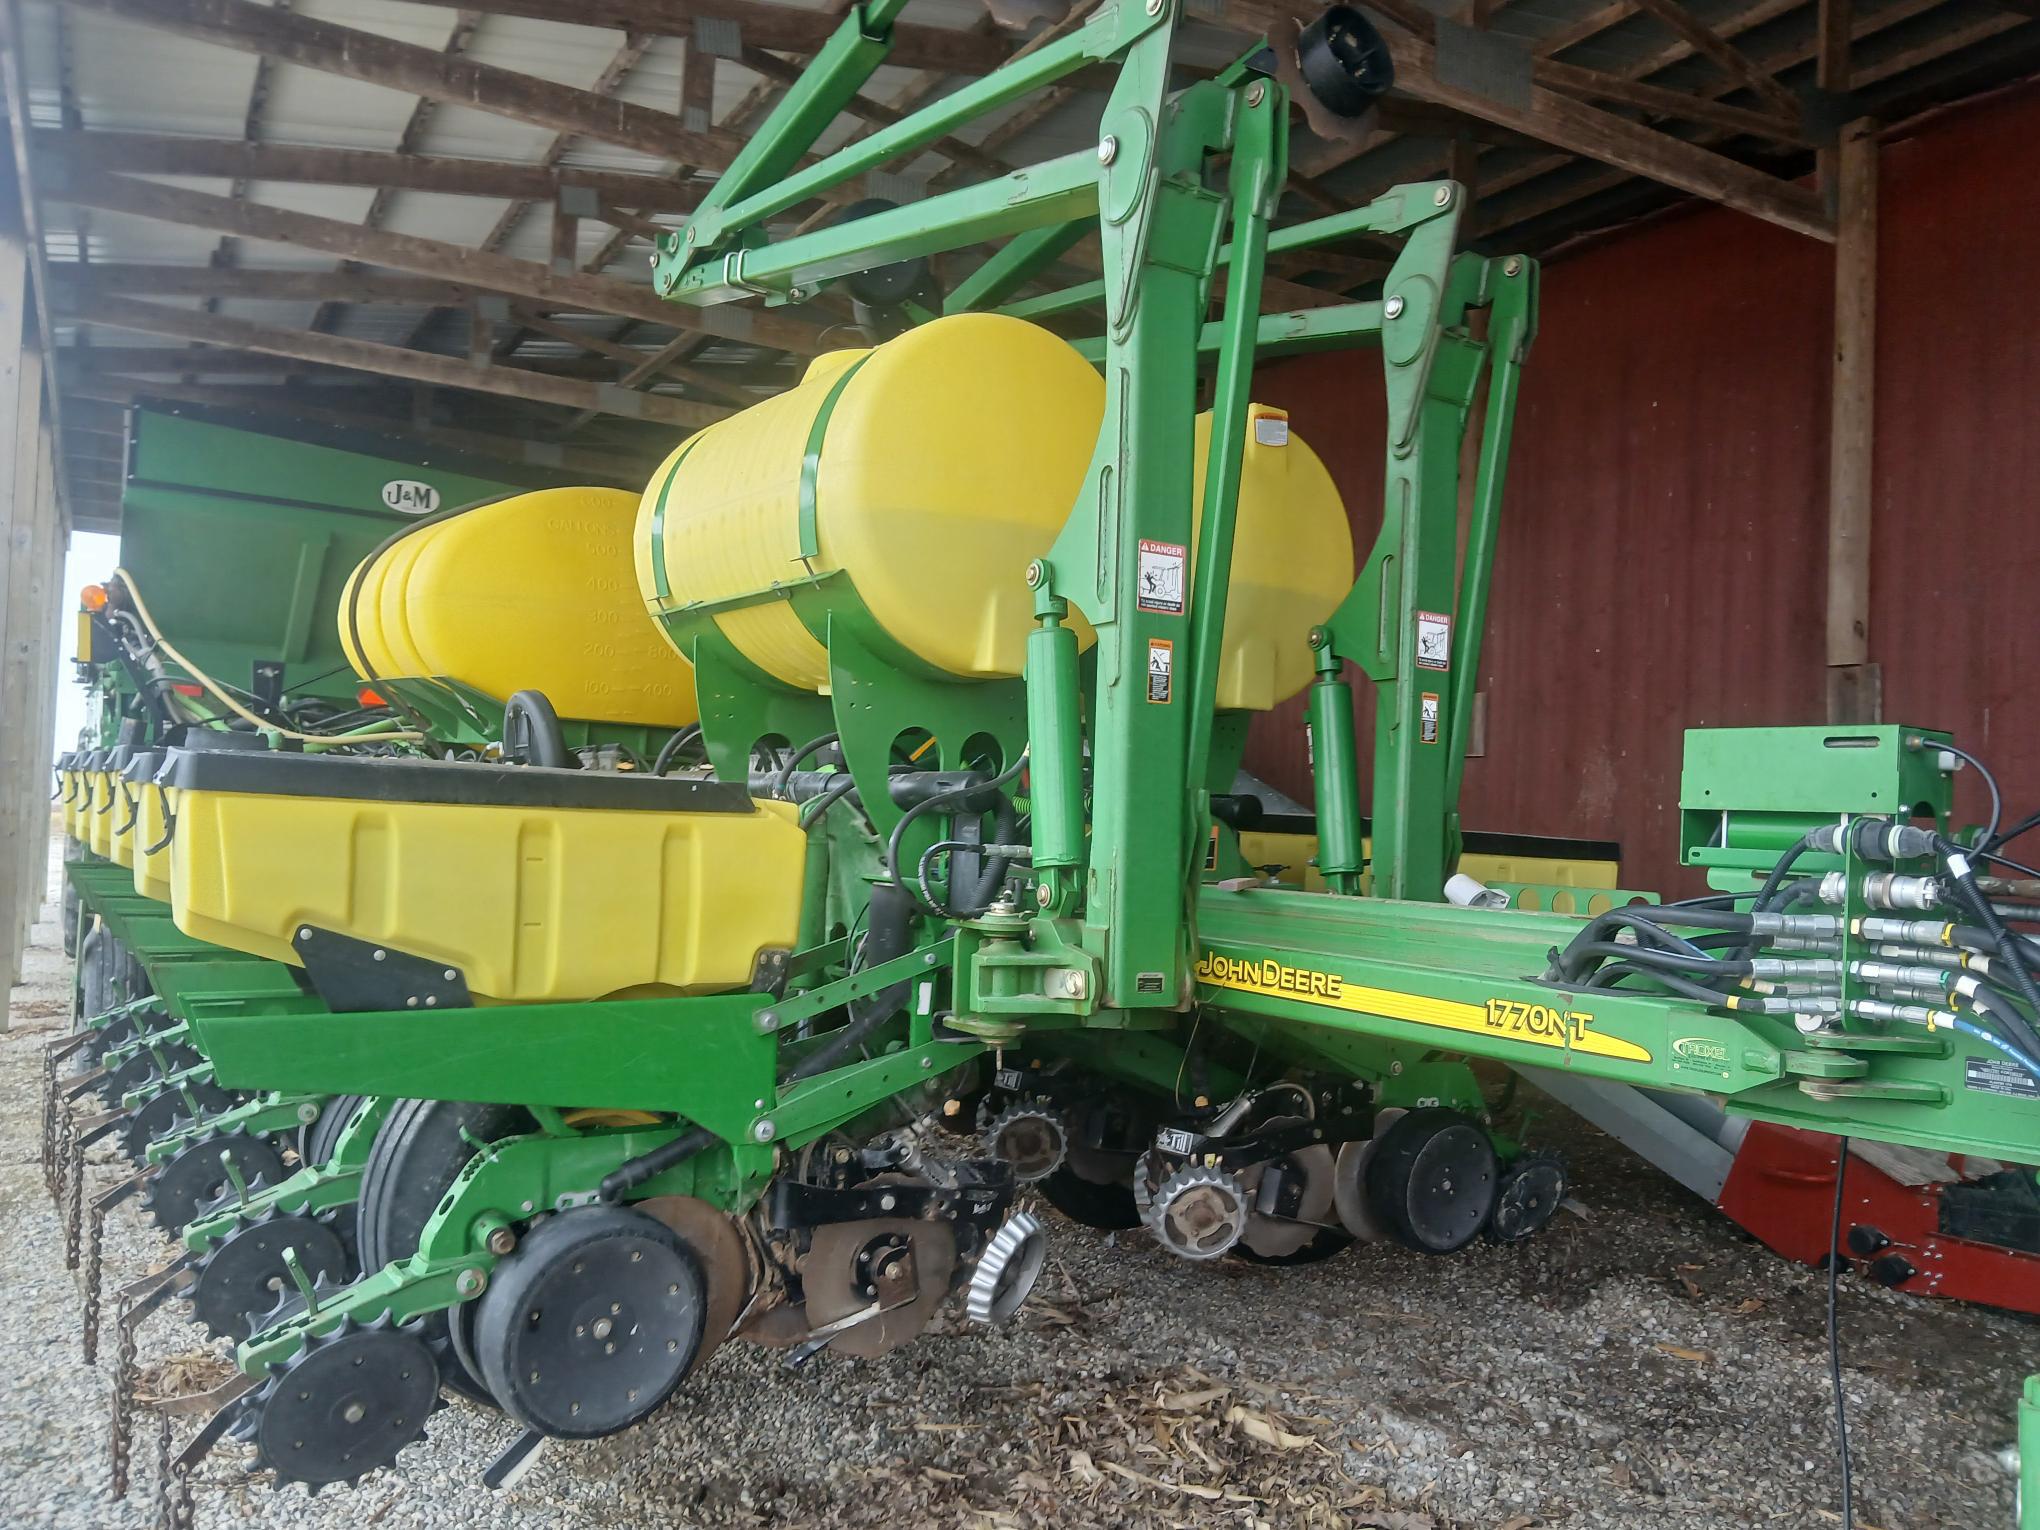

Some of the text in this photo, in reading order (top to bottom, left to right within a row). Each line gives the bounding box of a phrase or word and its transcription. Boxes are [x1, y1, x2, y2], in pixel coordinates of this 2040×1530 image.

[387, 483, 432, 509] J&M
[1150, 543, 1182, 556] DANGER
[585, 576, 618, 592] 400
[1426, 614, 1448, 624] DANGER
[583, 642, 616, 657] 200
[584, 680, 609, 696] 100
[1200, 951, 1259, 984] JOHN
[1262, 959, 1343, 998] DEERE
[1486, 998, 1594, 1041] 1770NT
